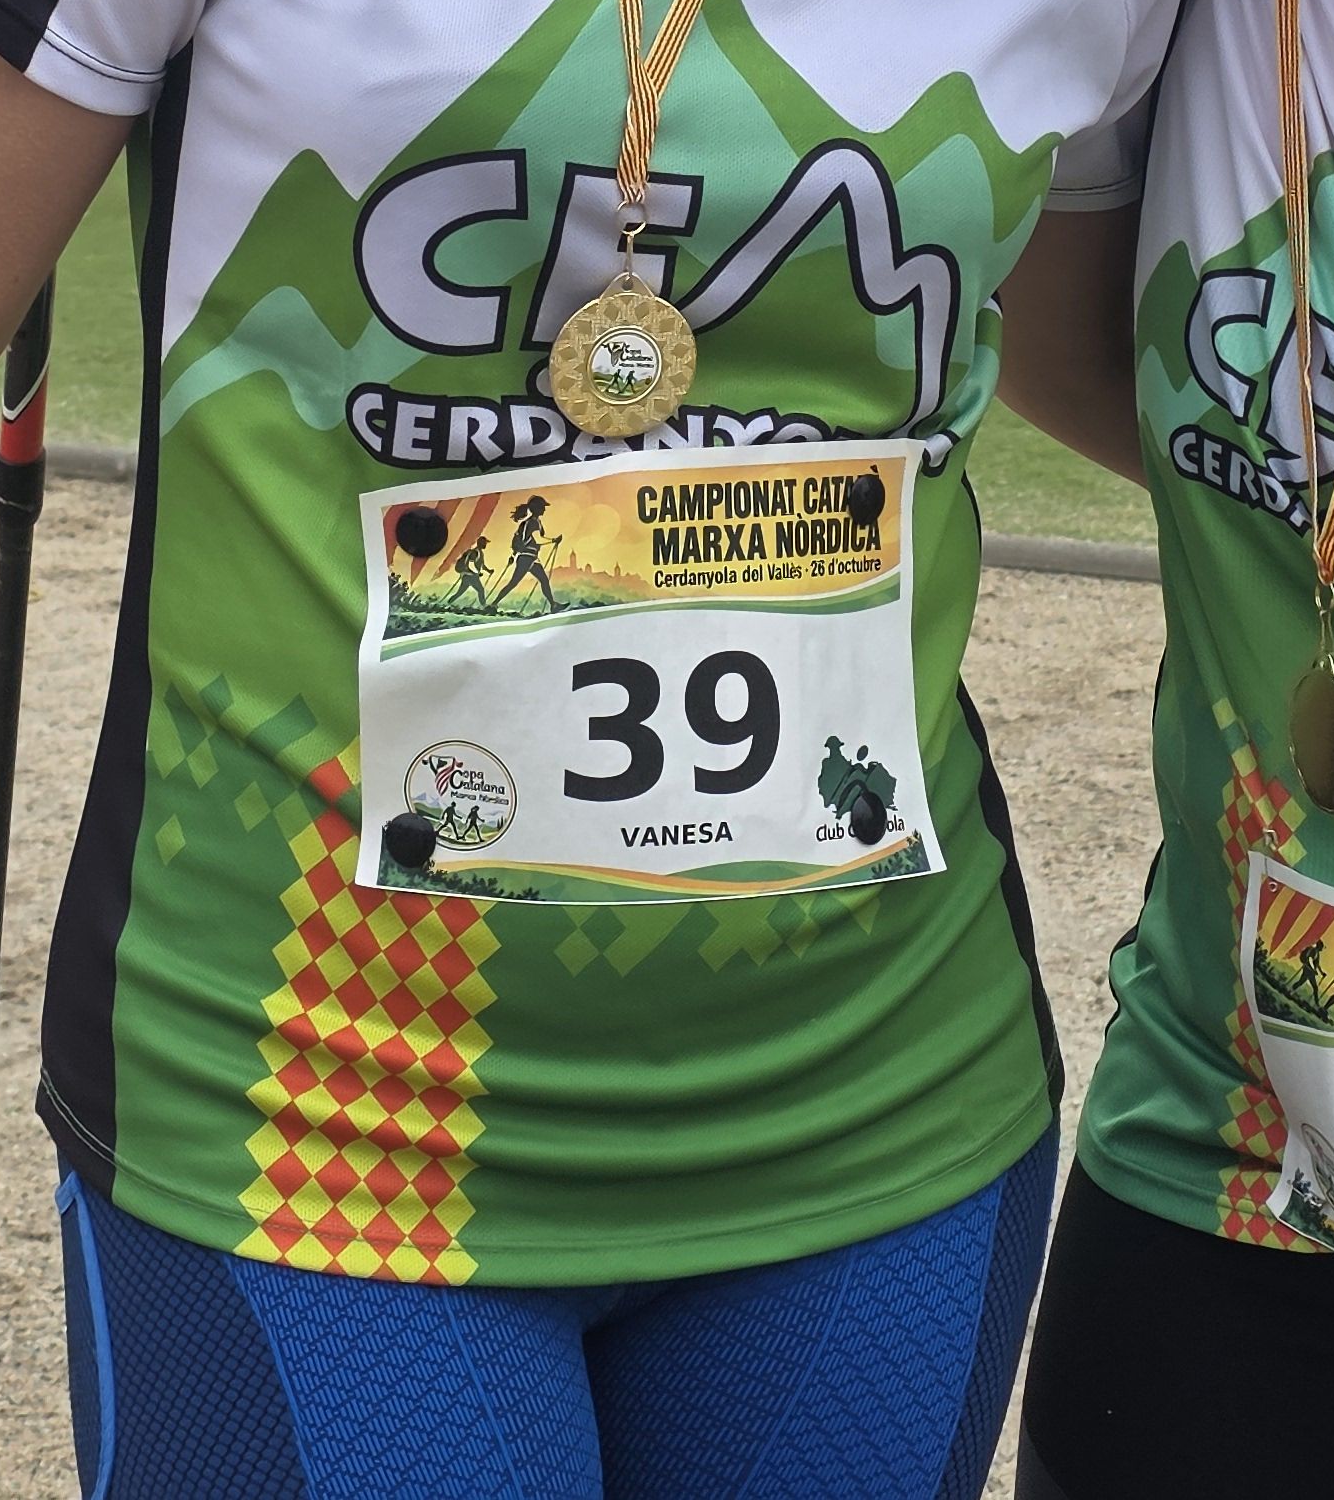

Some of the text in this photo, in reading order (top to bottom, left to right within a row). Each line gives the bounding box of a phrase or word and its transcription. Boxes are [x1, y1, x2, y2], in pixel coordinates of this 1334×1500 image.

[637, 465, 880, 524] CAMPIONAT CATA
[652, 512, 881, 566] MARXA NÒRDICA
[654, 569, 737, 589] Cerdanyola
[768, 560, 802, 581] Vallès
[811, 559, 825, 578] 26
[828, 555, 881, 574] d'octubre
[564, 650, 781, 803] 39
[620, 821, 734, 848] VANESA
[816, 822, 845, 842] Club
